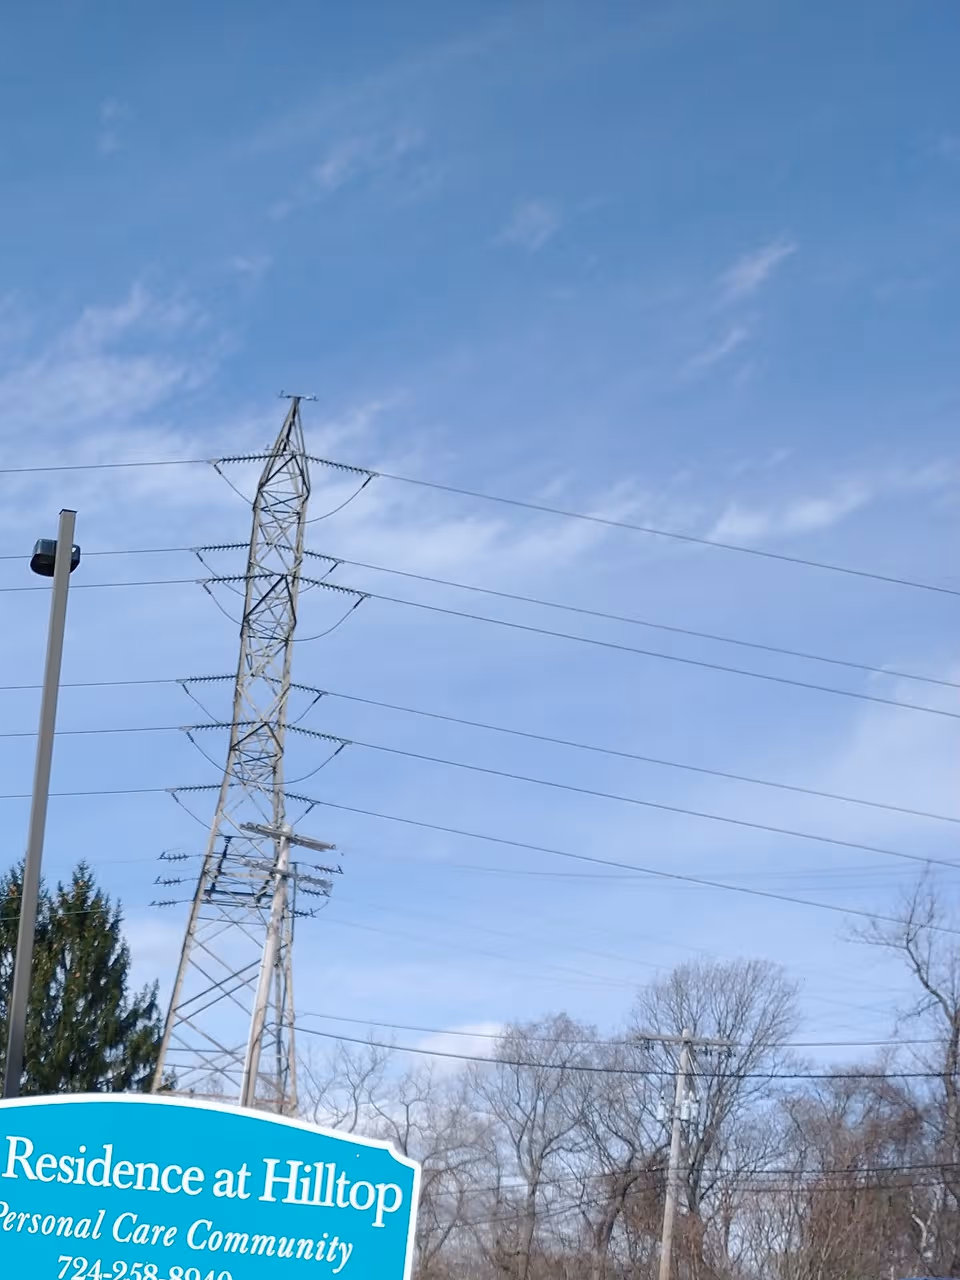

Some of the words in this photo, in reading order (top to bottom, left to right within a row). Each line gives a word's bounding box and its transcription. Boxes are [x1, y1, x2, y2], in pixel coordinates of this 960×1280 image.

[2, 1136, 204, 1195] Residence
[213, 1163, 251, 1199] at
[259, 1159, 402, 1227] Hilltop
[113, 1213, 177, 1246] Care
[187, 1219, 353, 1273] Community
